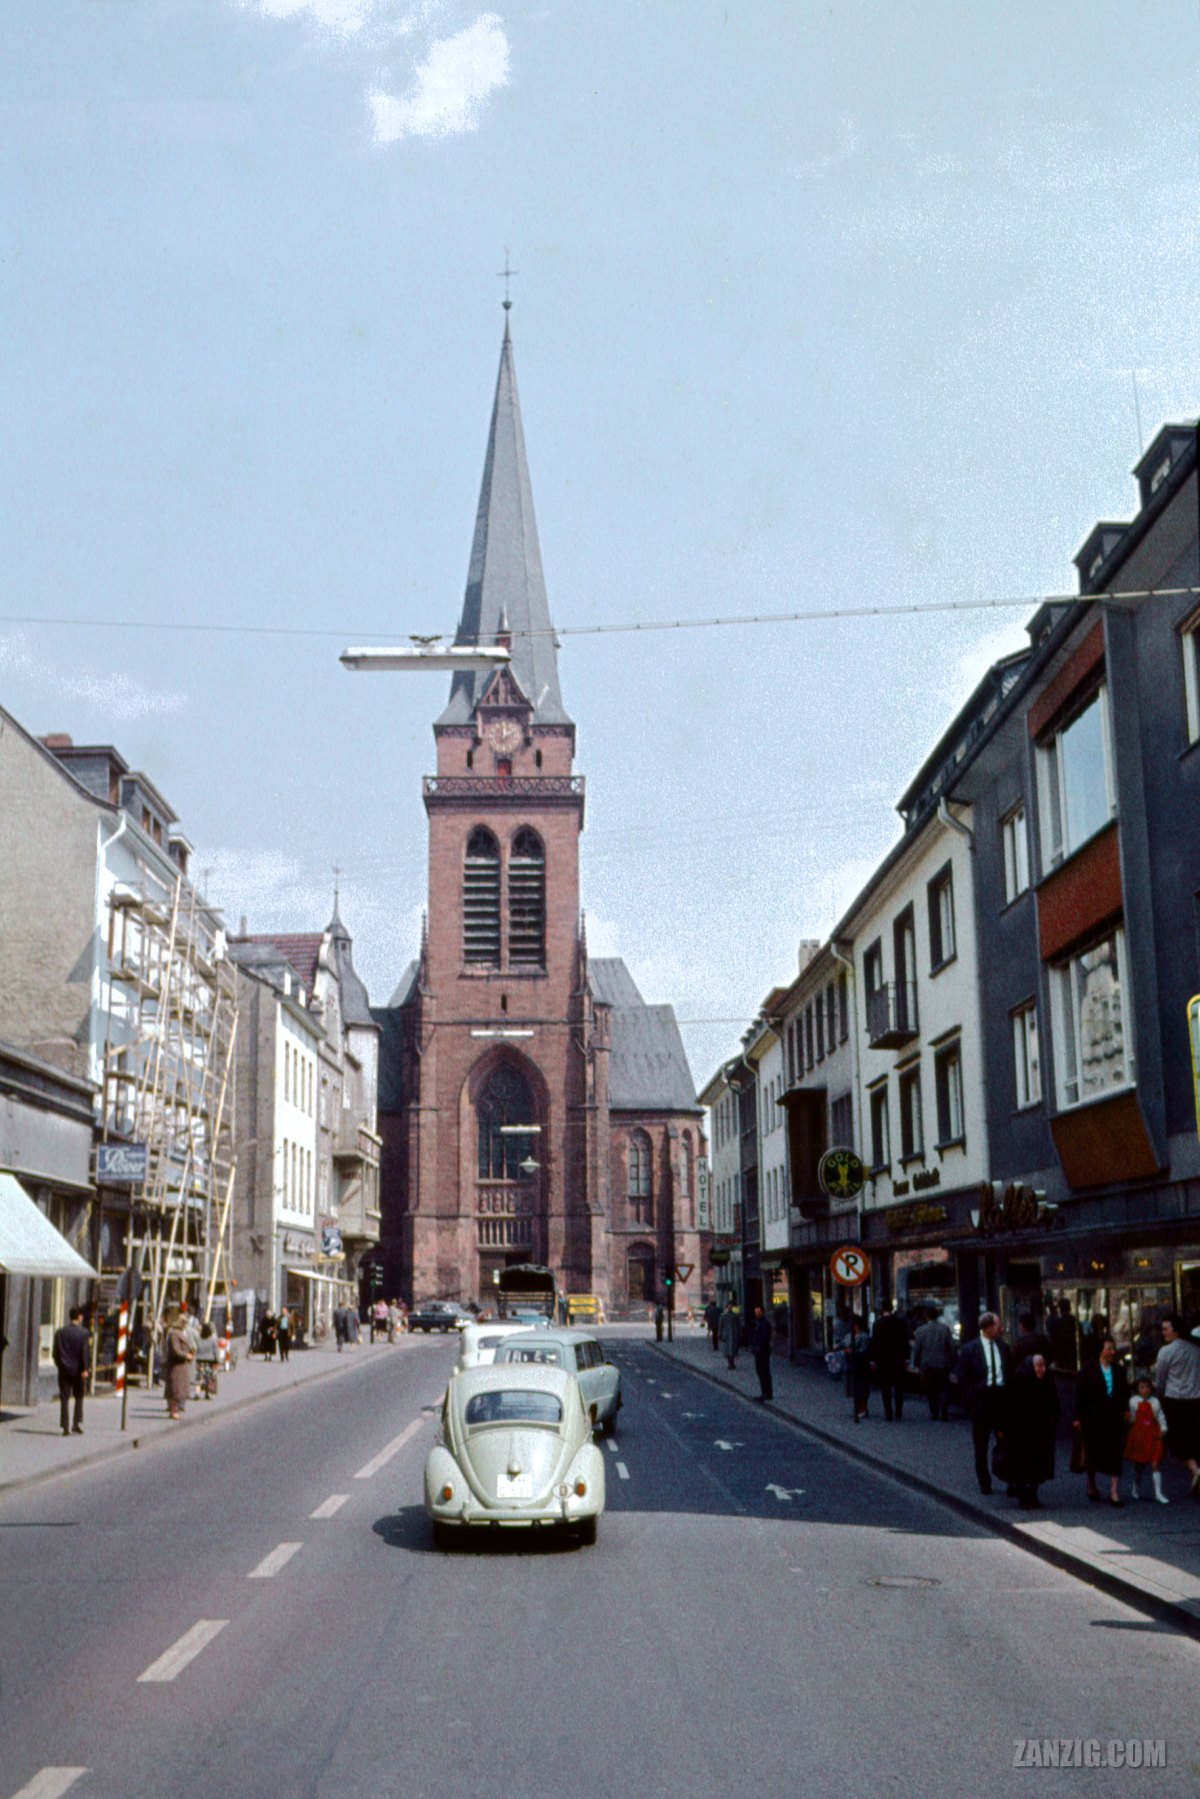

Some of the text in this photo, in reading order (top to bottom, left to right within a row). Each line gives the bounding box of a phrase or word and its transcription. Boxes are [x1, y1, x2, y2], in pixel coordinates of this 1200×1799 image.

[827, 1153, 859, 1169] GOLD
[698, 1161, 707, 1227] HOTEL
[845, 1254, 859, 1277] P
